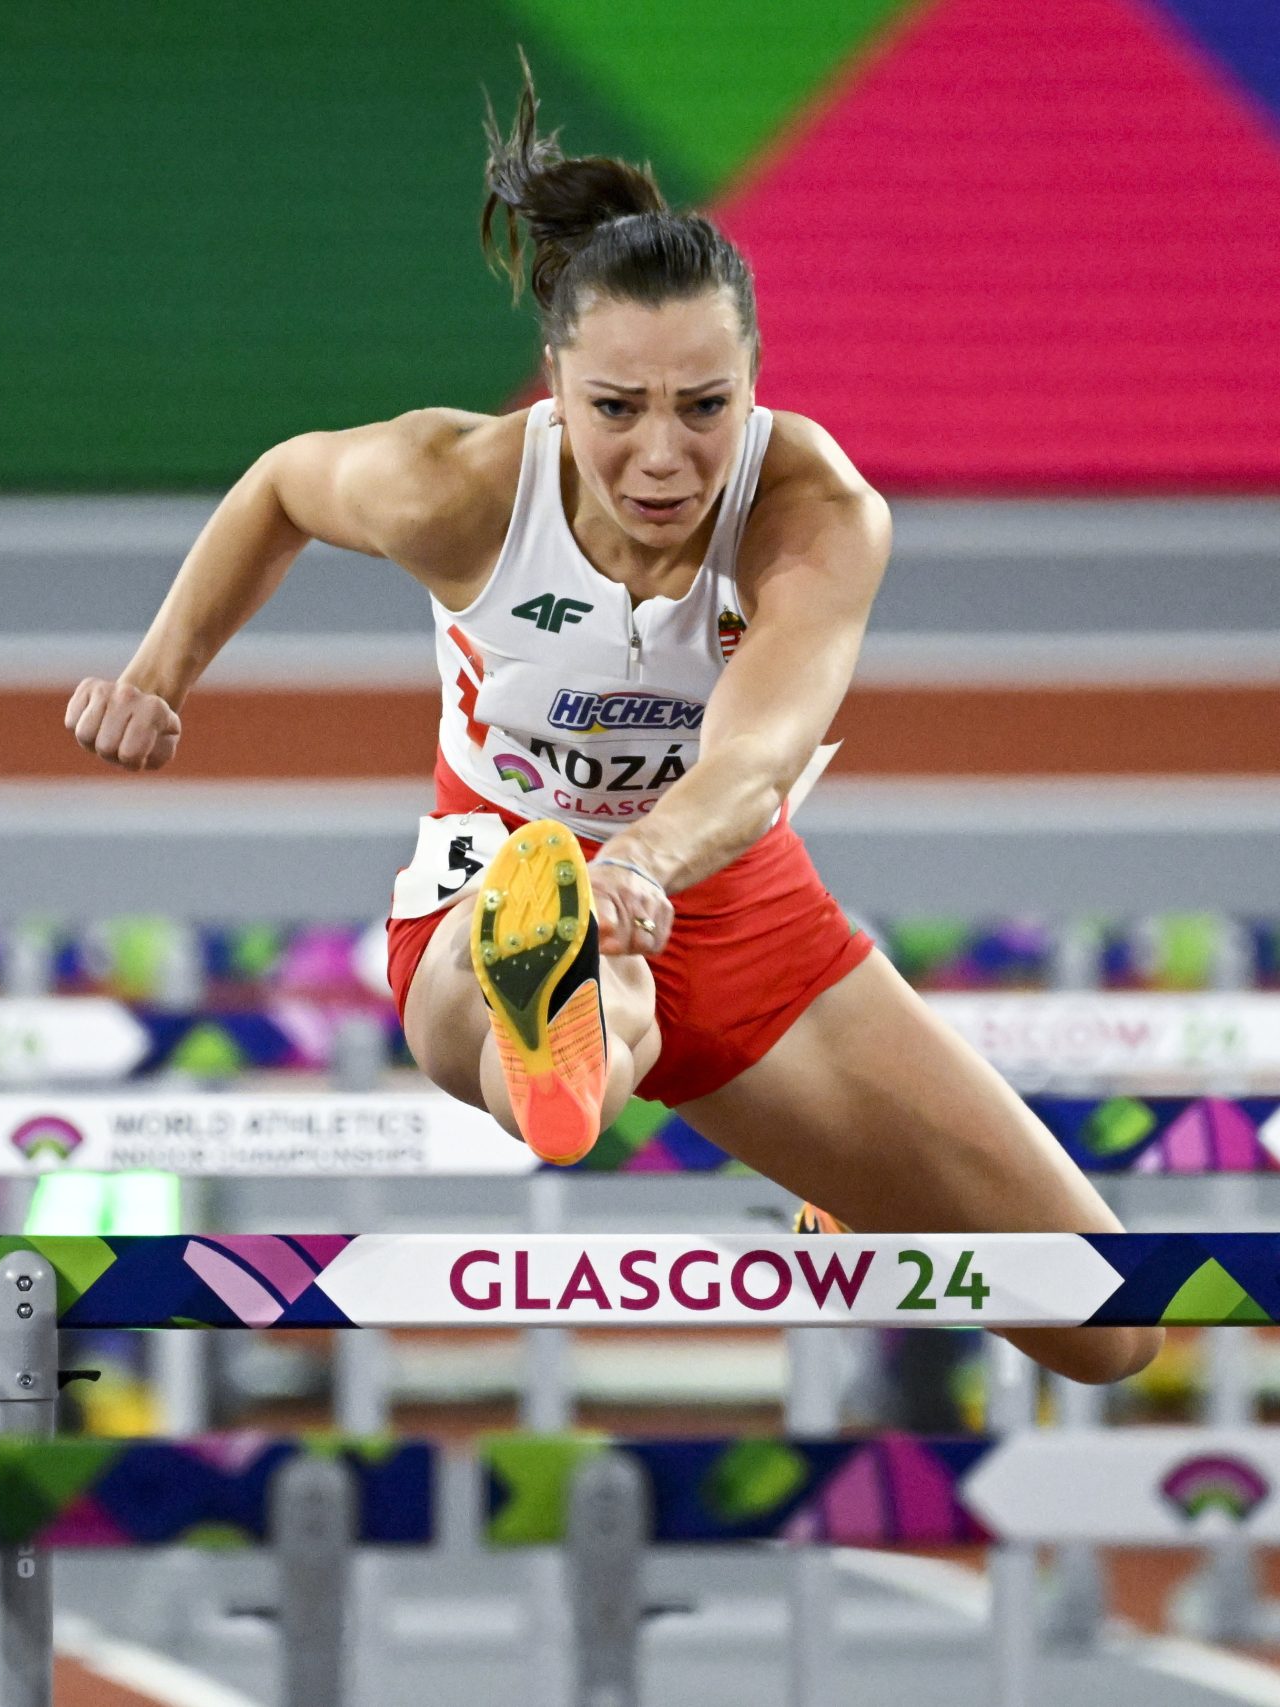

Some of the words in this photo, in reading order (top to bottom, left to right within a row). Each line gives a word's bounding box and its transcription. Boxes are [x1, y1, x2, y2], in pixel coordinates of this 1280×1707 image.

[511, 593, 594, 633] 4F
[548, 689, 706, 730] HI-CHEW
[449, 1250, 876, 1311] GLASGOW
[896, 1250, 990, 1310] 24
